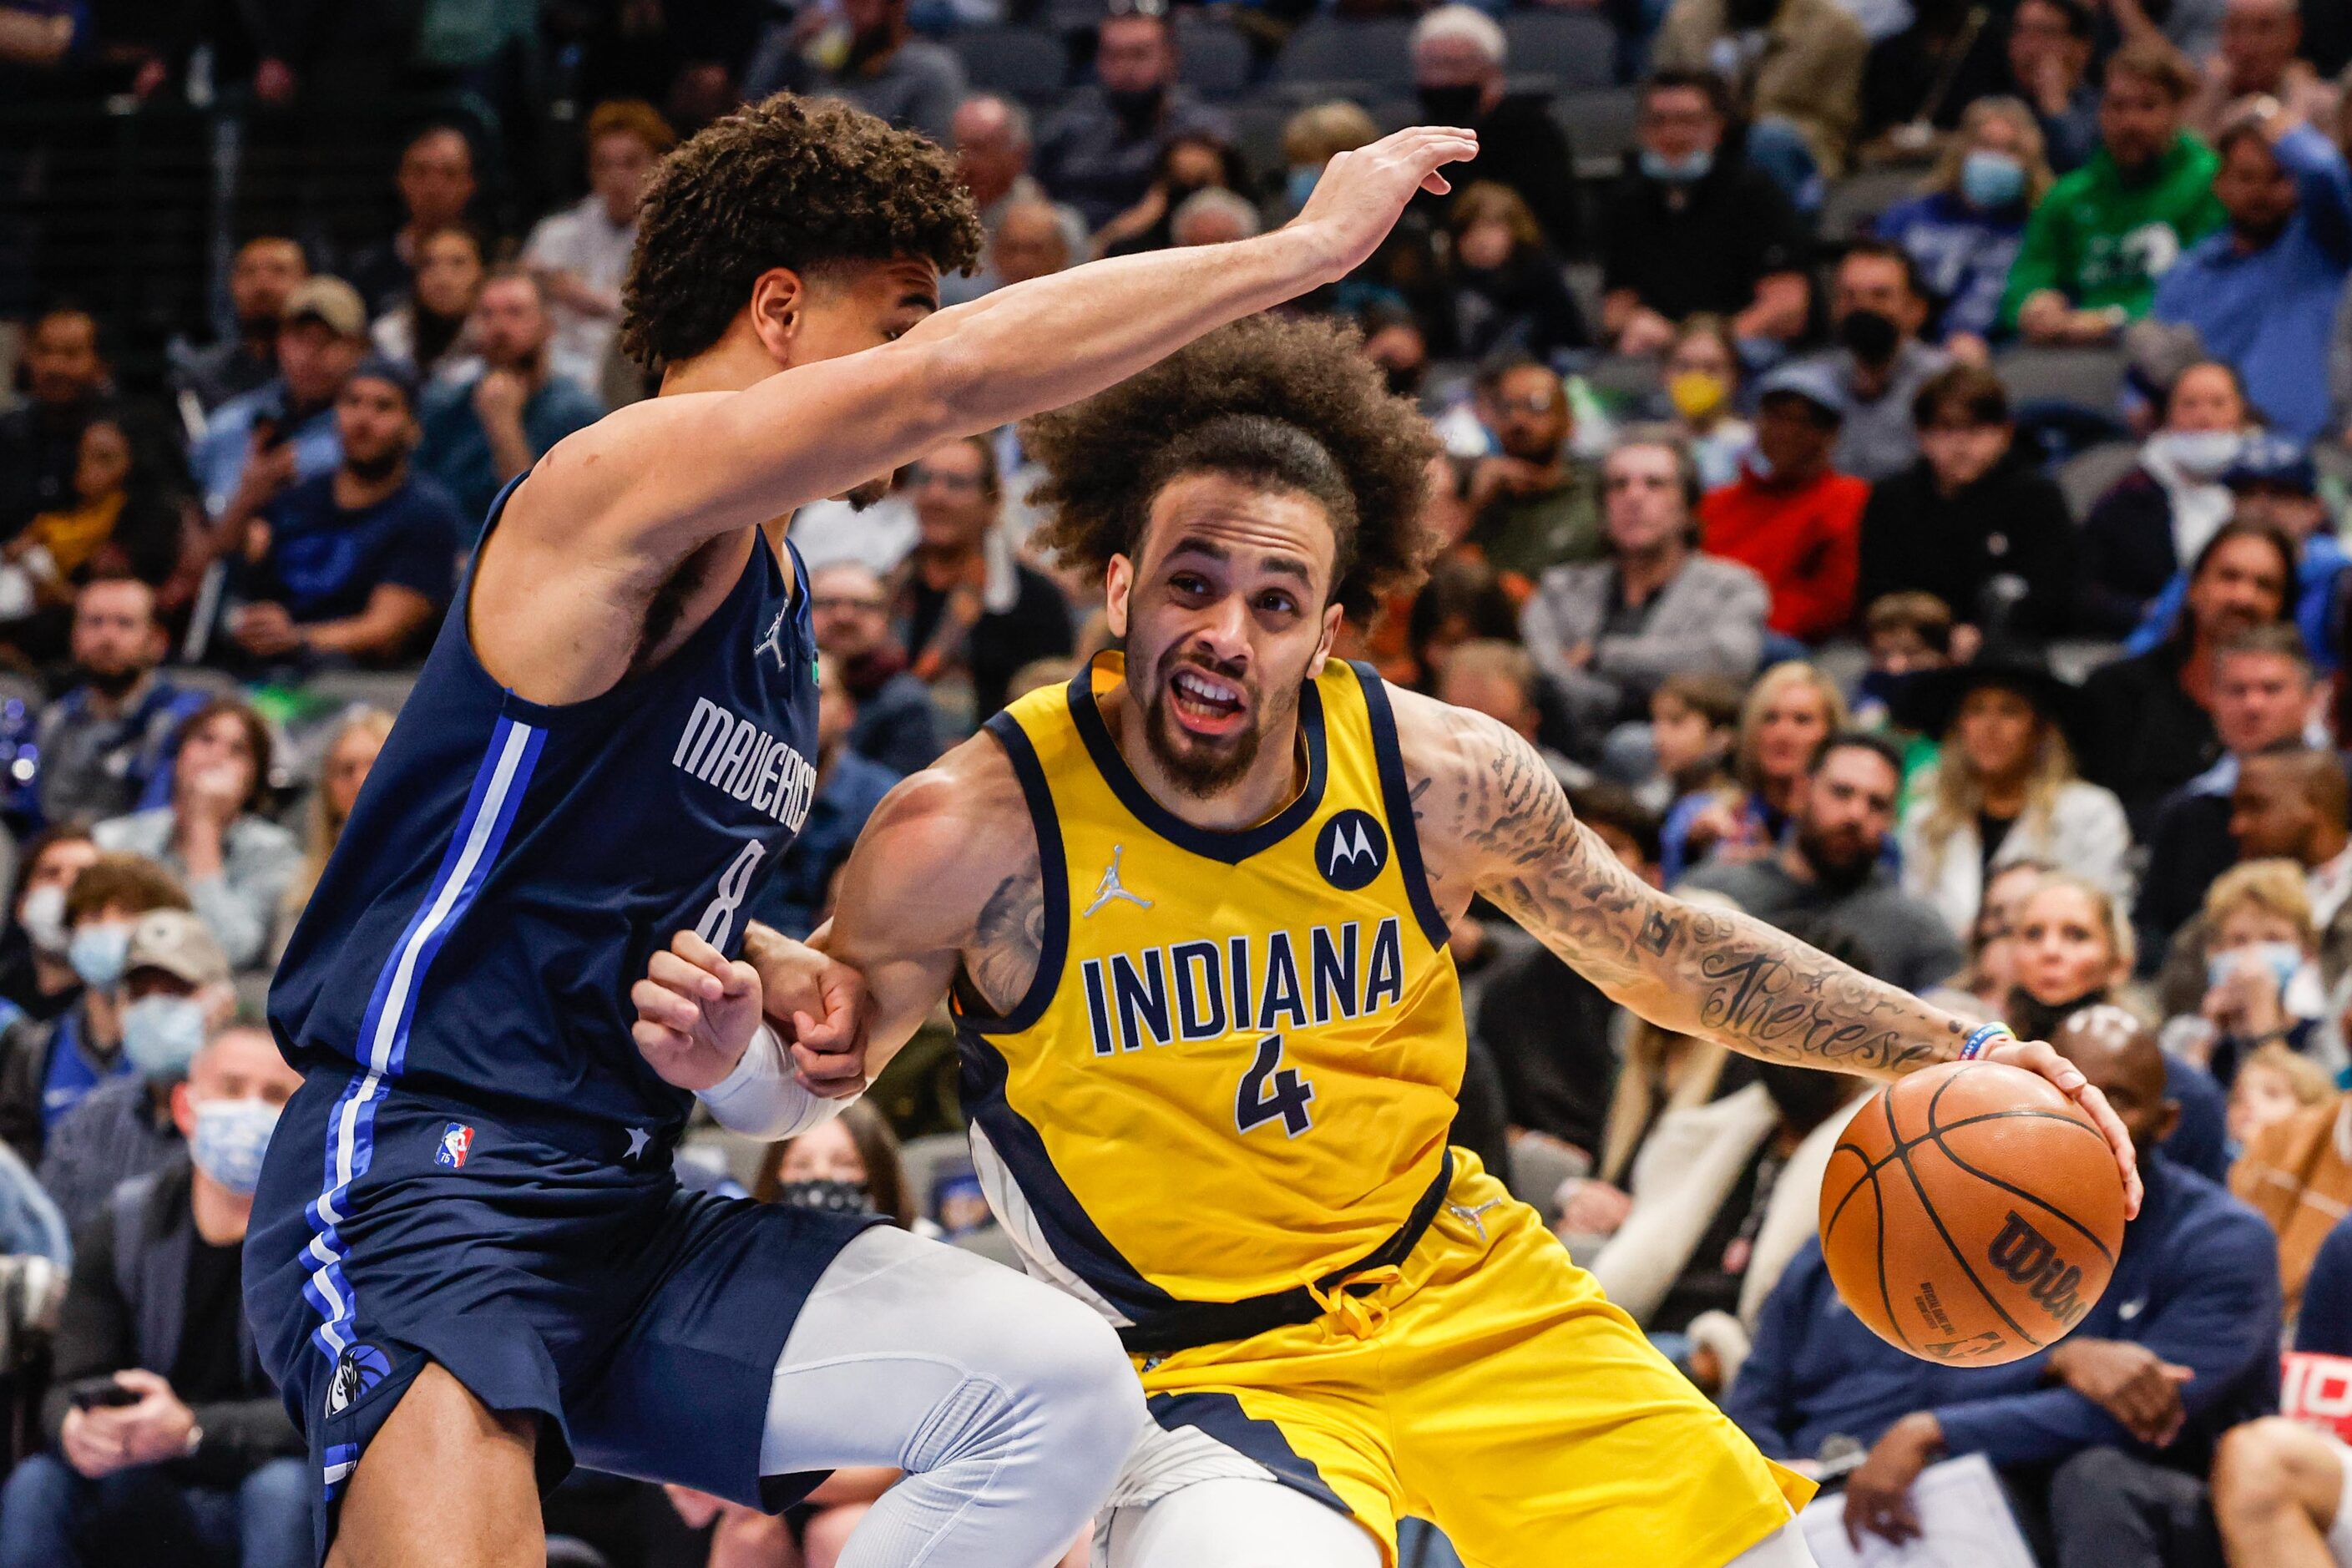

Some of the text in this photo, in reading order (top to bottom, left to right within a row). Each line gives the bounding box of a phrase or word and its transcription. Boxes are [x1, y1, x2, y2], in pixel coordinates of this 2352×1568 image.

[694, 838, 766, 955] 8
[1080, 915, 1404, 1058] INDIANA
[1701, 953, 1934, 1074] Therese
[1234, 1034, 1316, 1141] 4
